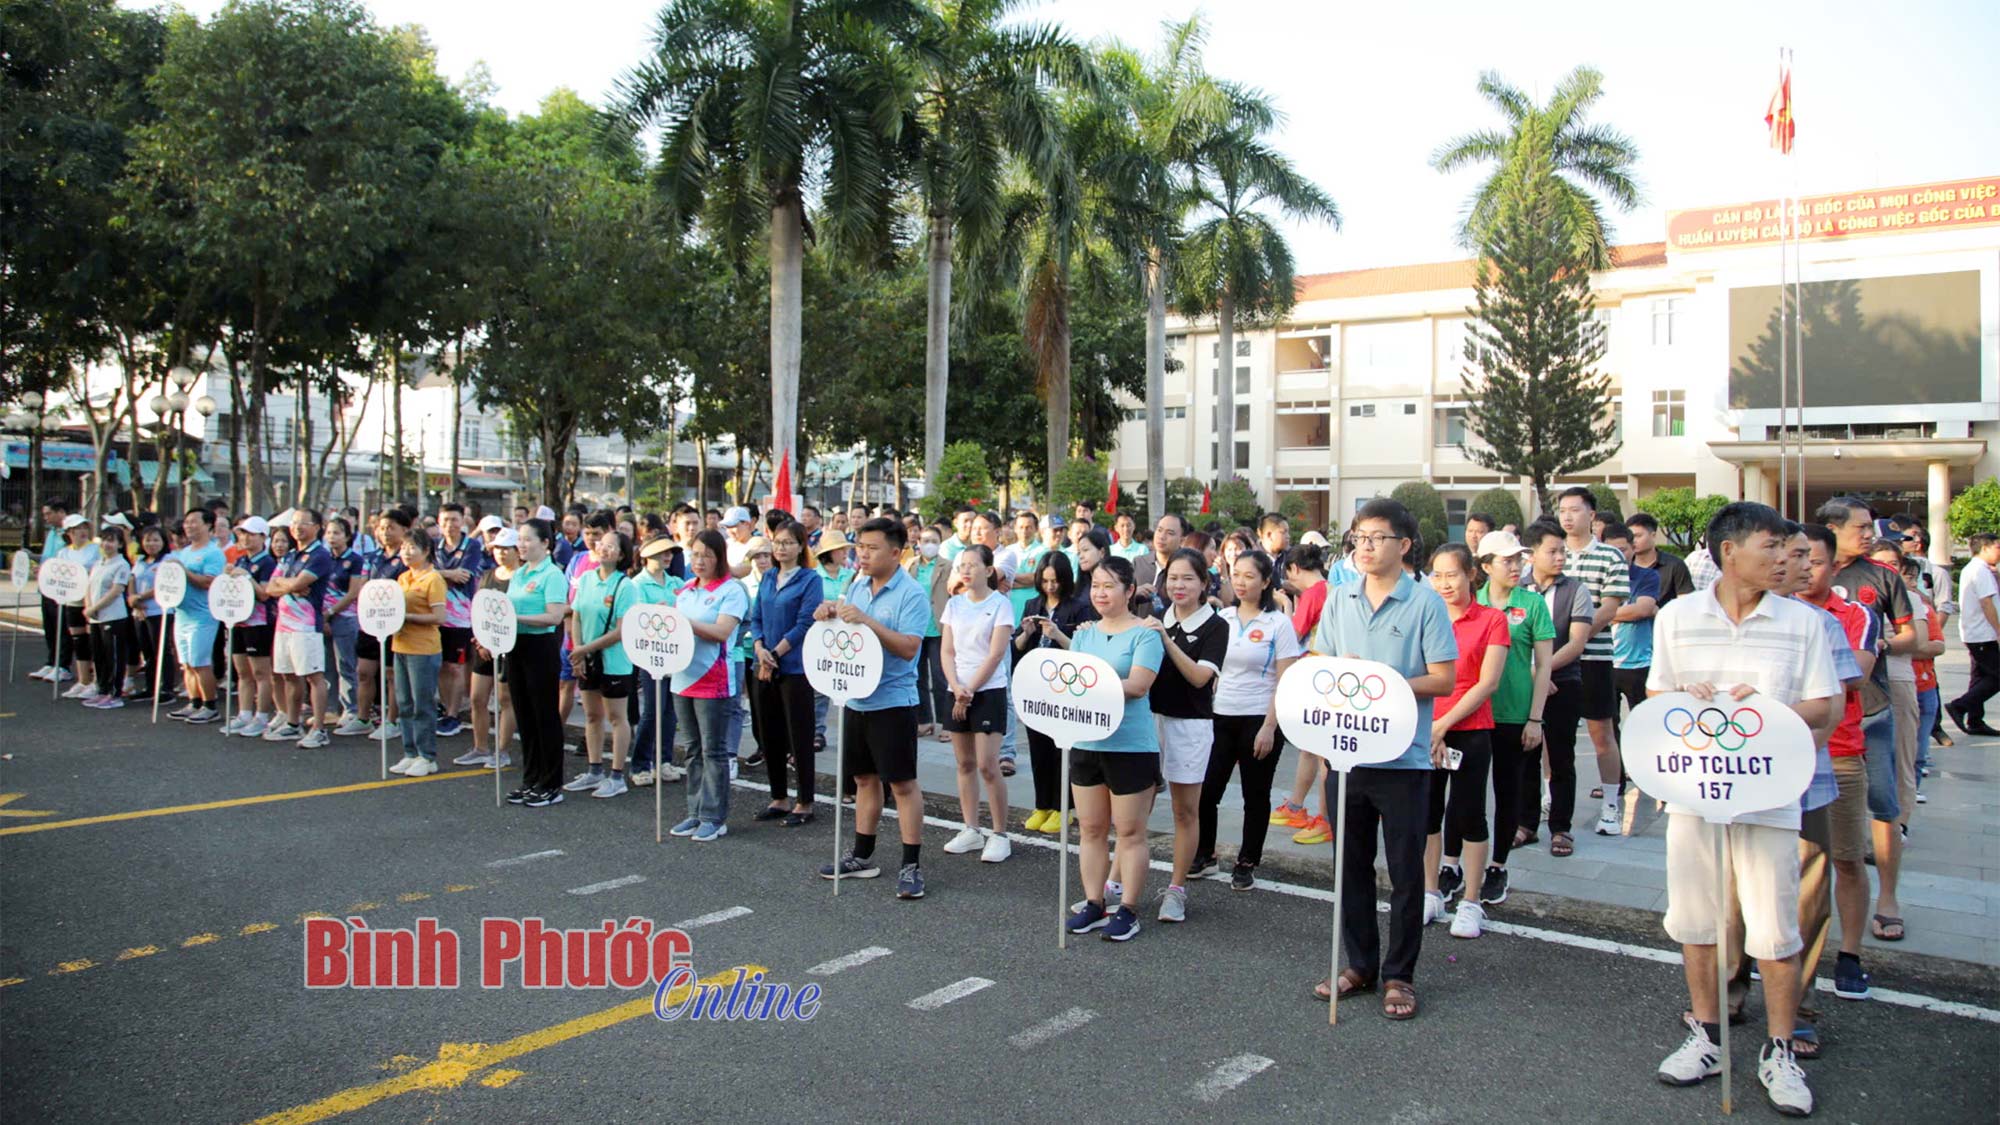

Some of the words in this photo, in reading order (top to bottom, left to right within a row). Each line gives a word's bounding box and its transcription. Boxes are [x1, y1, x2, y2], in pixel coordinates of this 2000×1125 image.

[1713, 209, 1741, 225] CÁN
[1744, 207, 1762, 223] BỘ
[1814, 198, 1843, 215] GỐC
[1847, 195, 1877, 212] CỦA
[1879, 193, 1910, 209] MỌI
[1912, 188, 1956, 206] CÔNG
[1960, 184, 1997, 201] VIỆC
[1678, 228, 1714, 246] HUẤN
[1717, 225, 1759, 242] LUYỆN
[1816, 217, 1834, 233] LÀ
[1838, 216, 1878, 232] CÔNG
[1881, 211, 1915, 228] VIỆC
[1919, 206, 1951, 224] GỐC
[651, 640, 679, 656] TCLLCT
[650, 655, 665, 668] 153
[817, 657, 833, 672] LỚP
[835, 661, 866, 678] TCLLCT
[832, 678, 848, 692] 154
[1023, 698, 1060, 719] TRƯỜNG
[1062, 705, 1092, 726] CHÍNH
[1095, 712, 1111, 732] TRỊ
[1303, 706, 1331, 727] LỚP
[1335, 712, 1390, 735] TCLLCT
[1332, 734, 1358, 753] 156
[1657, 751, 1693, 774] LỚP
[1699, 756, 1773, 775] TCLLCT
[1698, 782, 1734, 800] 157
